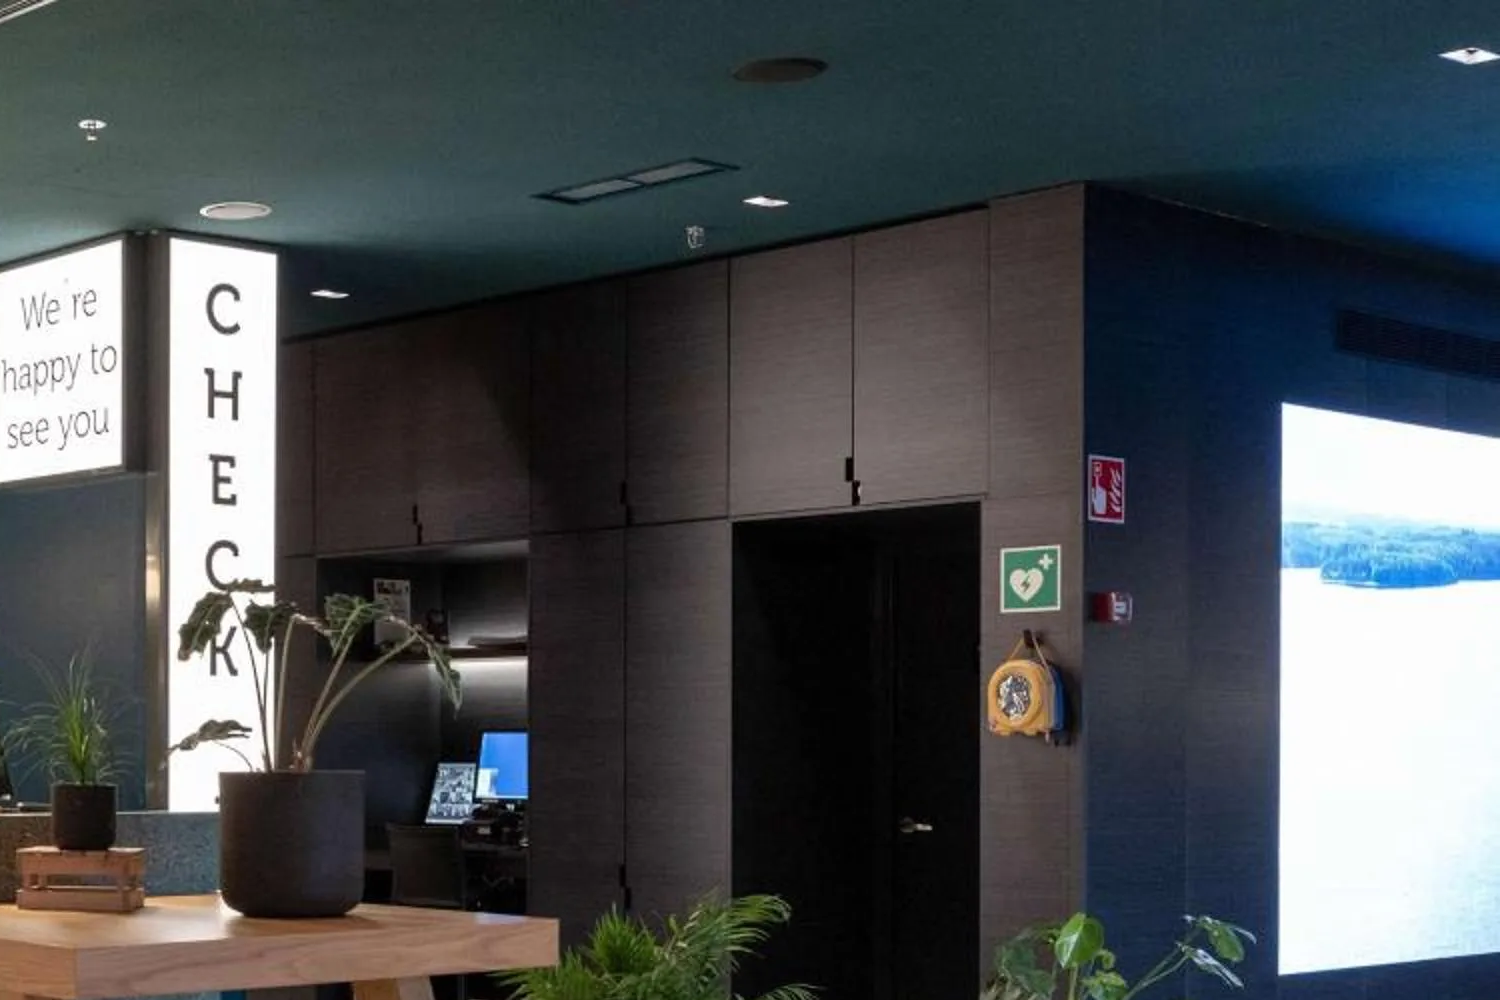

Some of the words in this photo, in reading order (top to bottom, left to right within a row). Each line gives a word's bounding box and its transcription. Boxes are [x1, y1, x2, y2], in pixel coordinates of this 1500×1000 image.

[1, 352, 82, 396] happy
[90, 343, 118, 375] to
[7, 417, 49, 449] see
[57, 407, 110, 451] you
[204, 282, 244, 677] CHECK
